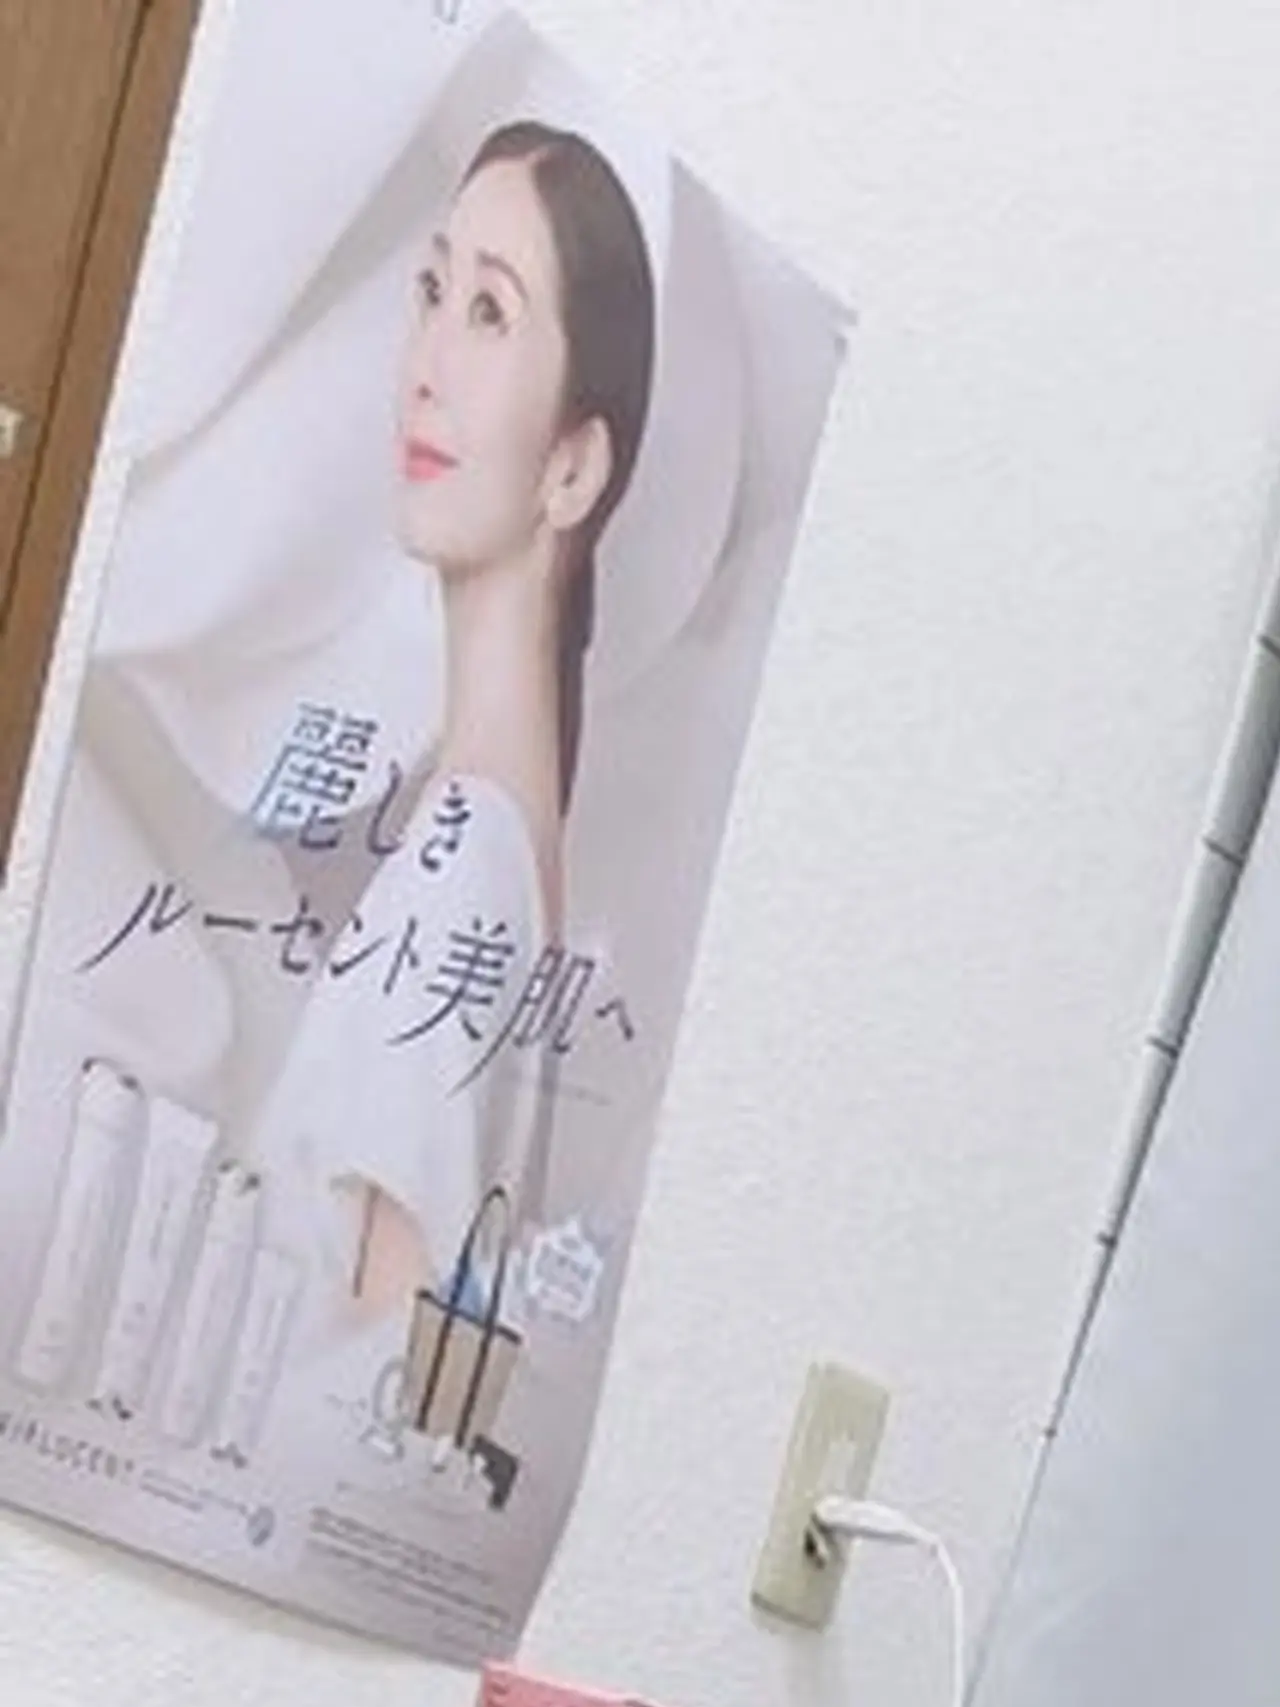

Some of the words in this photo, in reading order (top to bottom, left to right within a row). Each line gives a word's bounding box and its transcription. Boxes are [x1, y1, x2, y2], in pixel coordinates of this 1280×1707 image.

[252, 703, 472, 873] 麗しき
[75, 883, 636, 1098] ルーセント美肌へ
